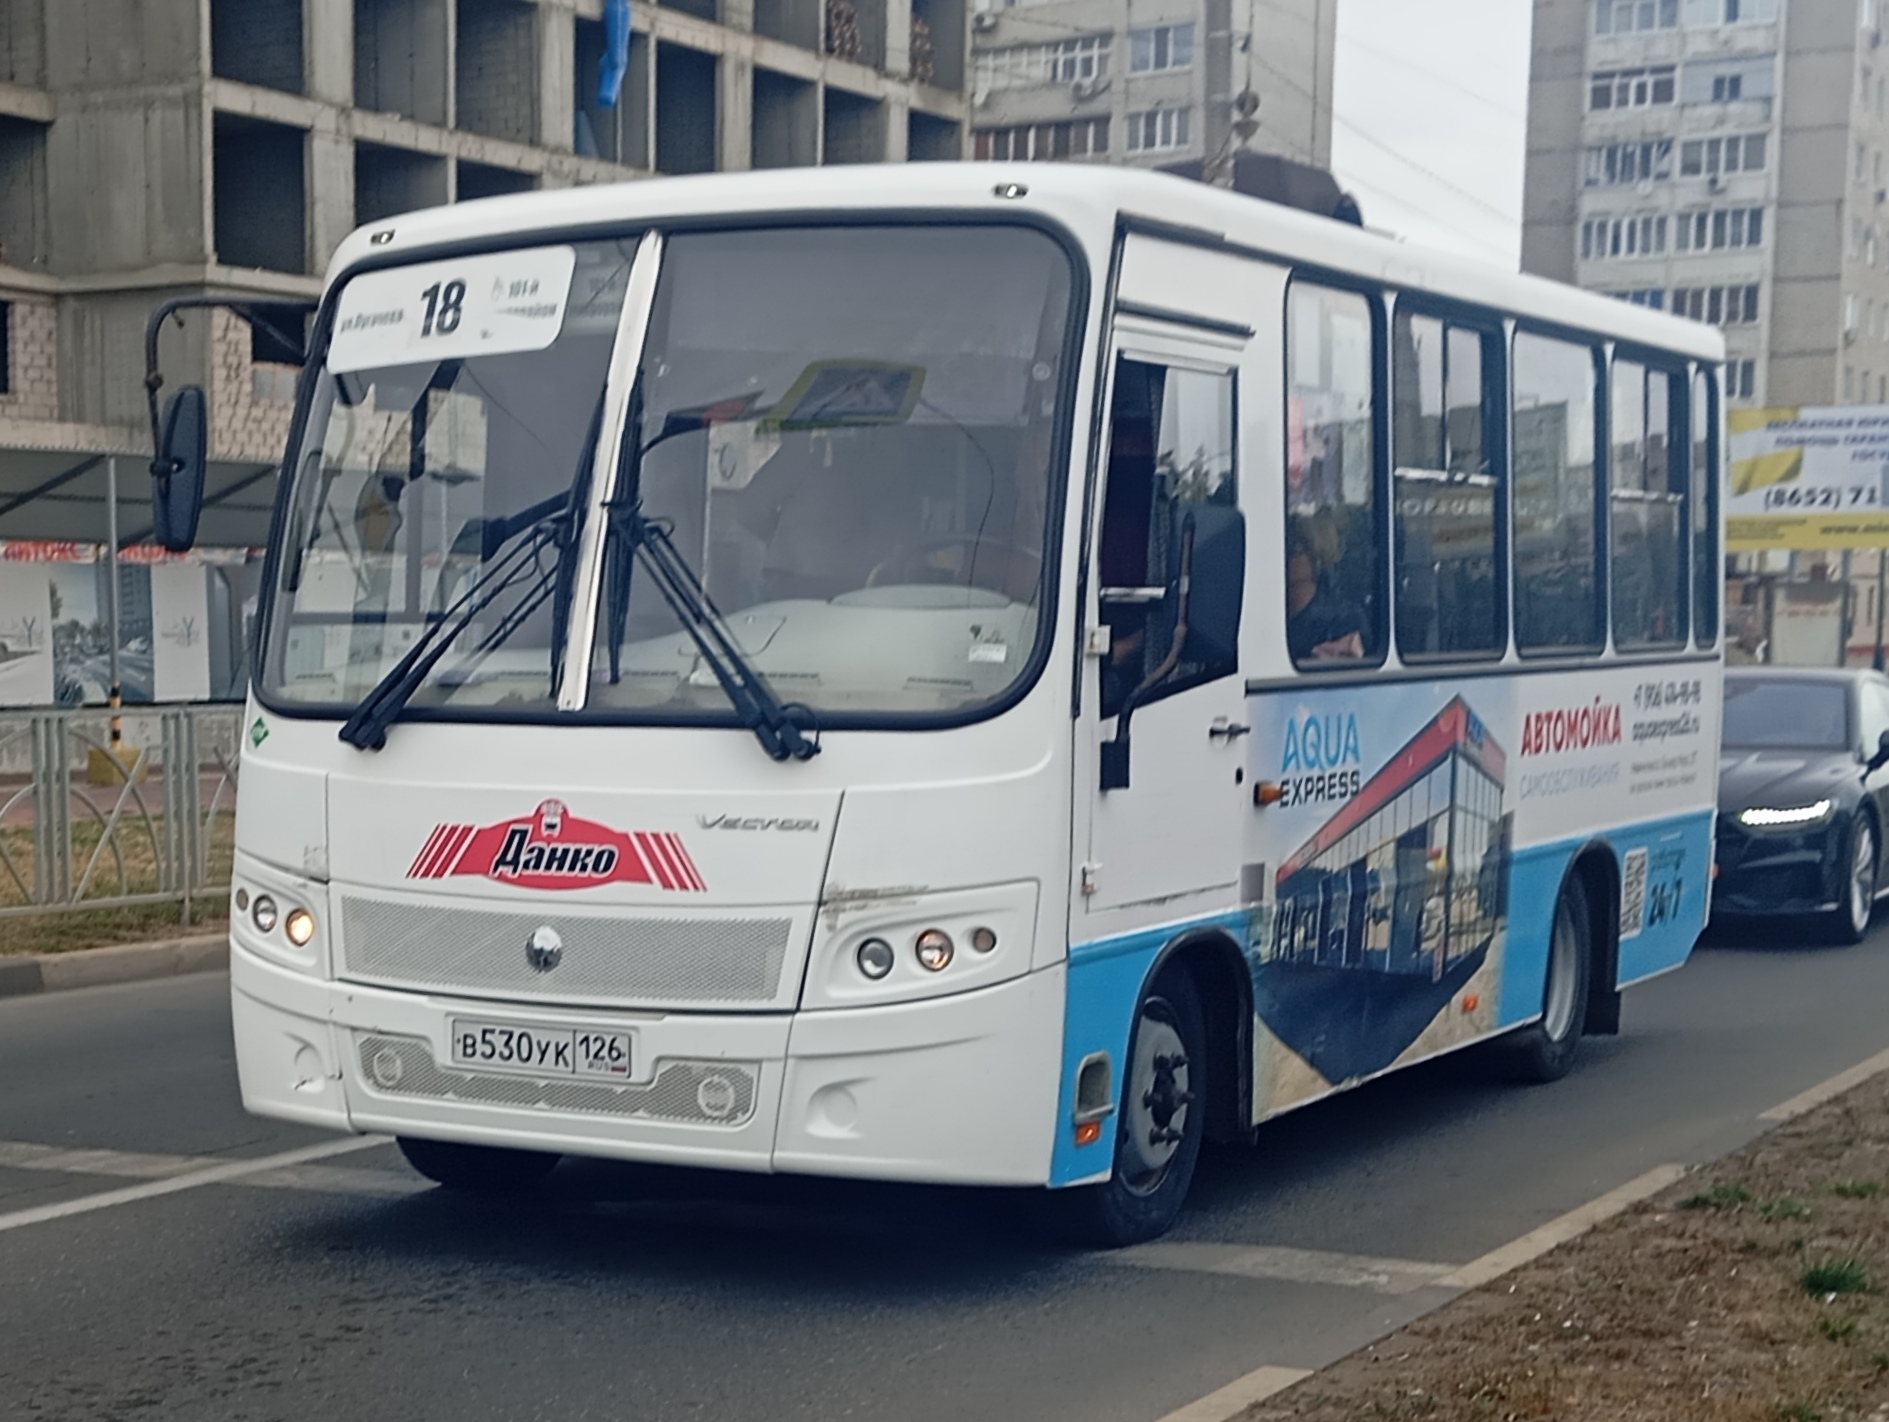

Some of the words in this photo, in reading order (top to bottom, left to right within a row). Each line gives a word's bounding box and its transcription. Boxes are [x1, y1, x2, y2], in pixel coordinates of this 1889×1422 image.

[420, 278, 467, 339] 18
[1764, 487, 1842, 512] (8652)
[1849, 486, 1877, 505] 71
[1281, 711, 1361, 774] AQUA
[1520, 694, 1622, 758] АВТОМОЙКА
[1279, 770, 1361, 808] EXPRESS
[490, 824, 618, 877] Данко
[462, 1028, 570, 1069] В530УК
[578, 1034, 622, 1062] 126
